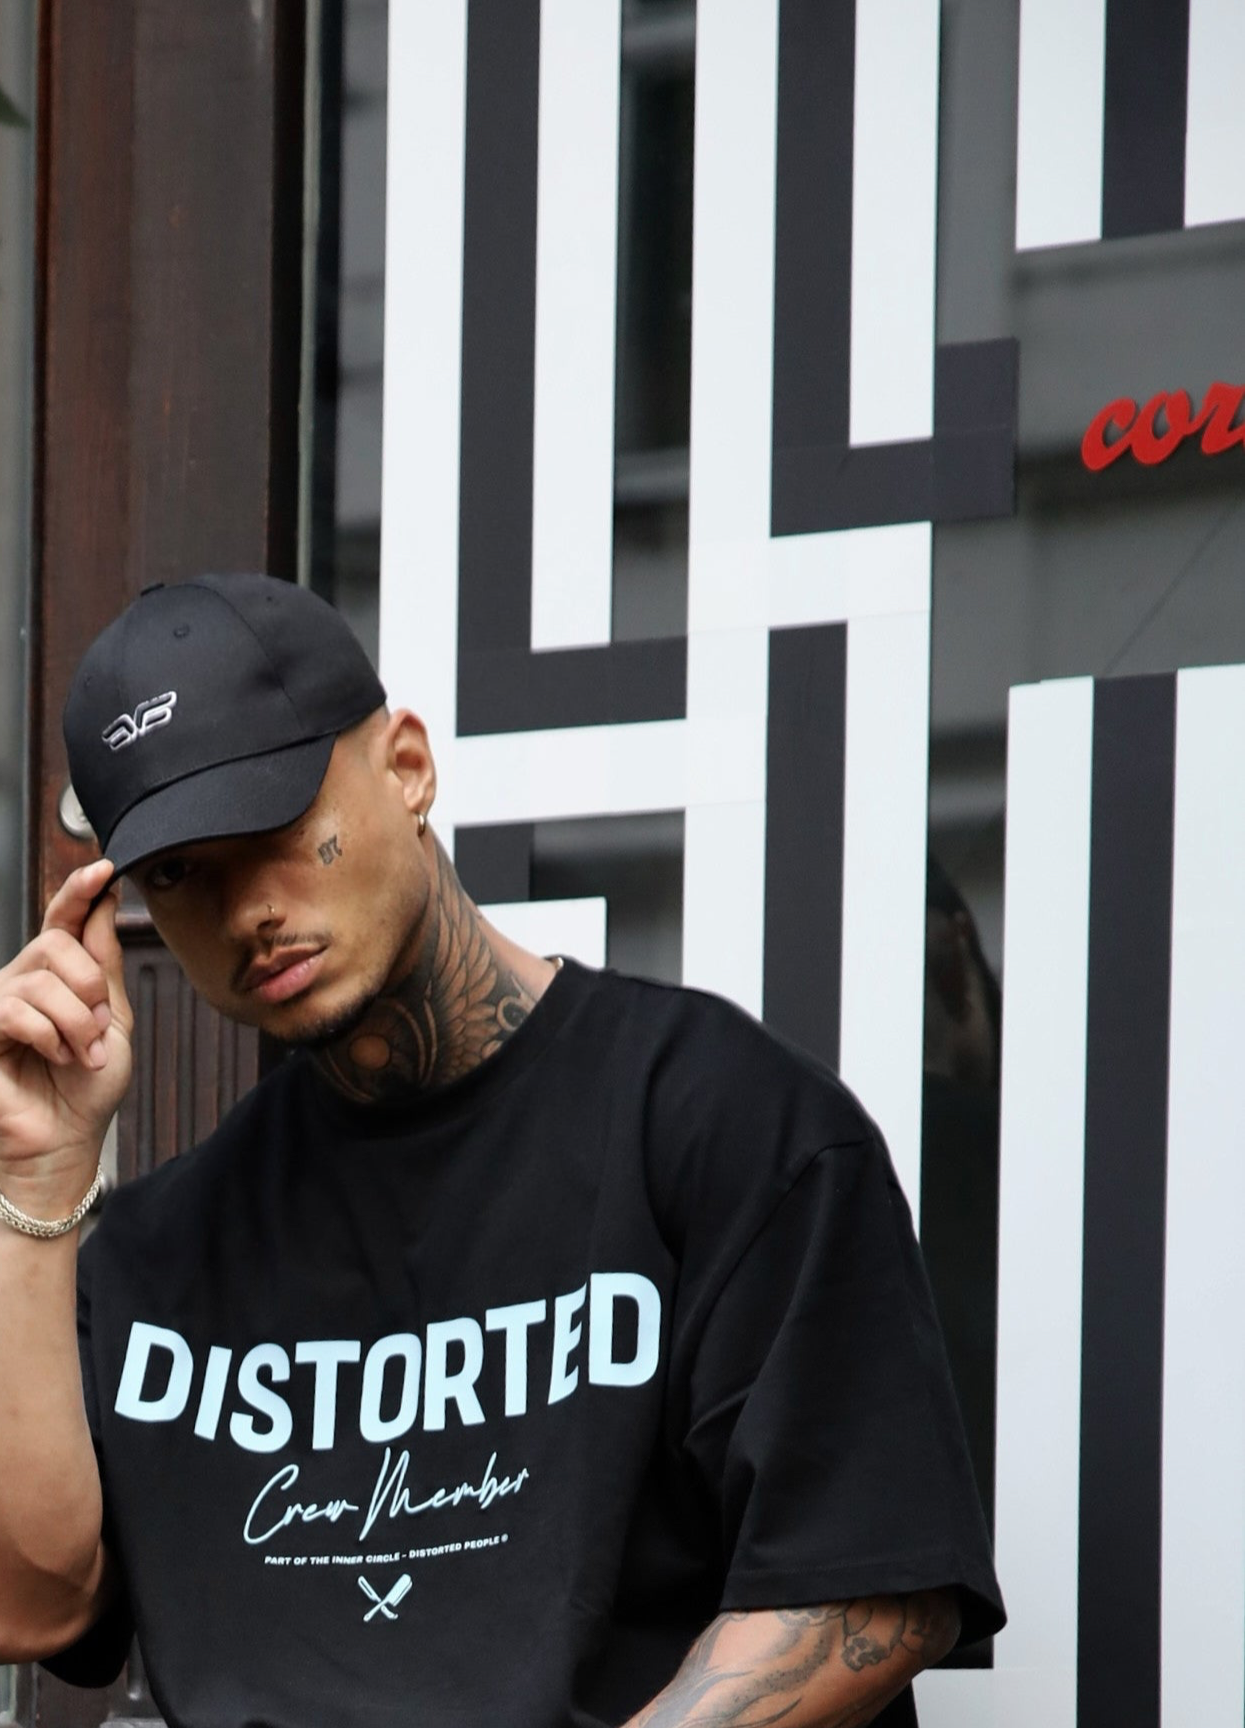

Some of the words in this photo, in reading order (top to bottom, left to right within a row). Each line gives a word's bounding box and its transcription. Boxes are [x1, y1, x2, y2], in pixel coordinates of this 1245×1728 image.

[1081, 380, 1245, 471] cor
[115, 1273, 661, 1453] DISTORTED
[243, 1464, 359, 1544] Crew
[358, 1447, 529, 1542] Member
[264, 1555, 293, 1566] PART
[293, 1556, 308, 1566] OF
[309, 1555, 330, 1566] THE
[331, 1554, 364, 1565] INNER
[364, 1551, 401, 1564] CIRCLE
[408, 1542, 463, 1559] DISTORTED
[463, 1535, 500, 1551] PEOPLE
